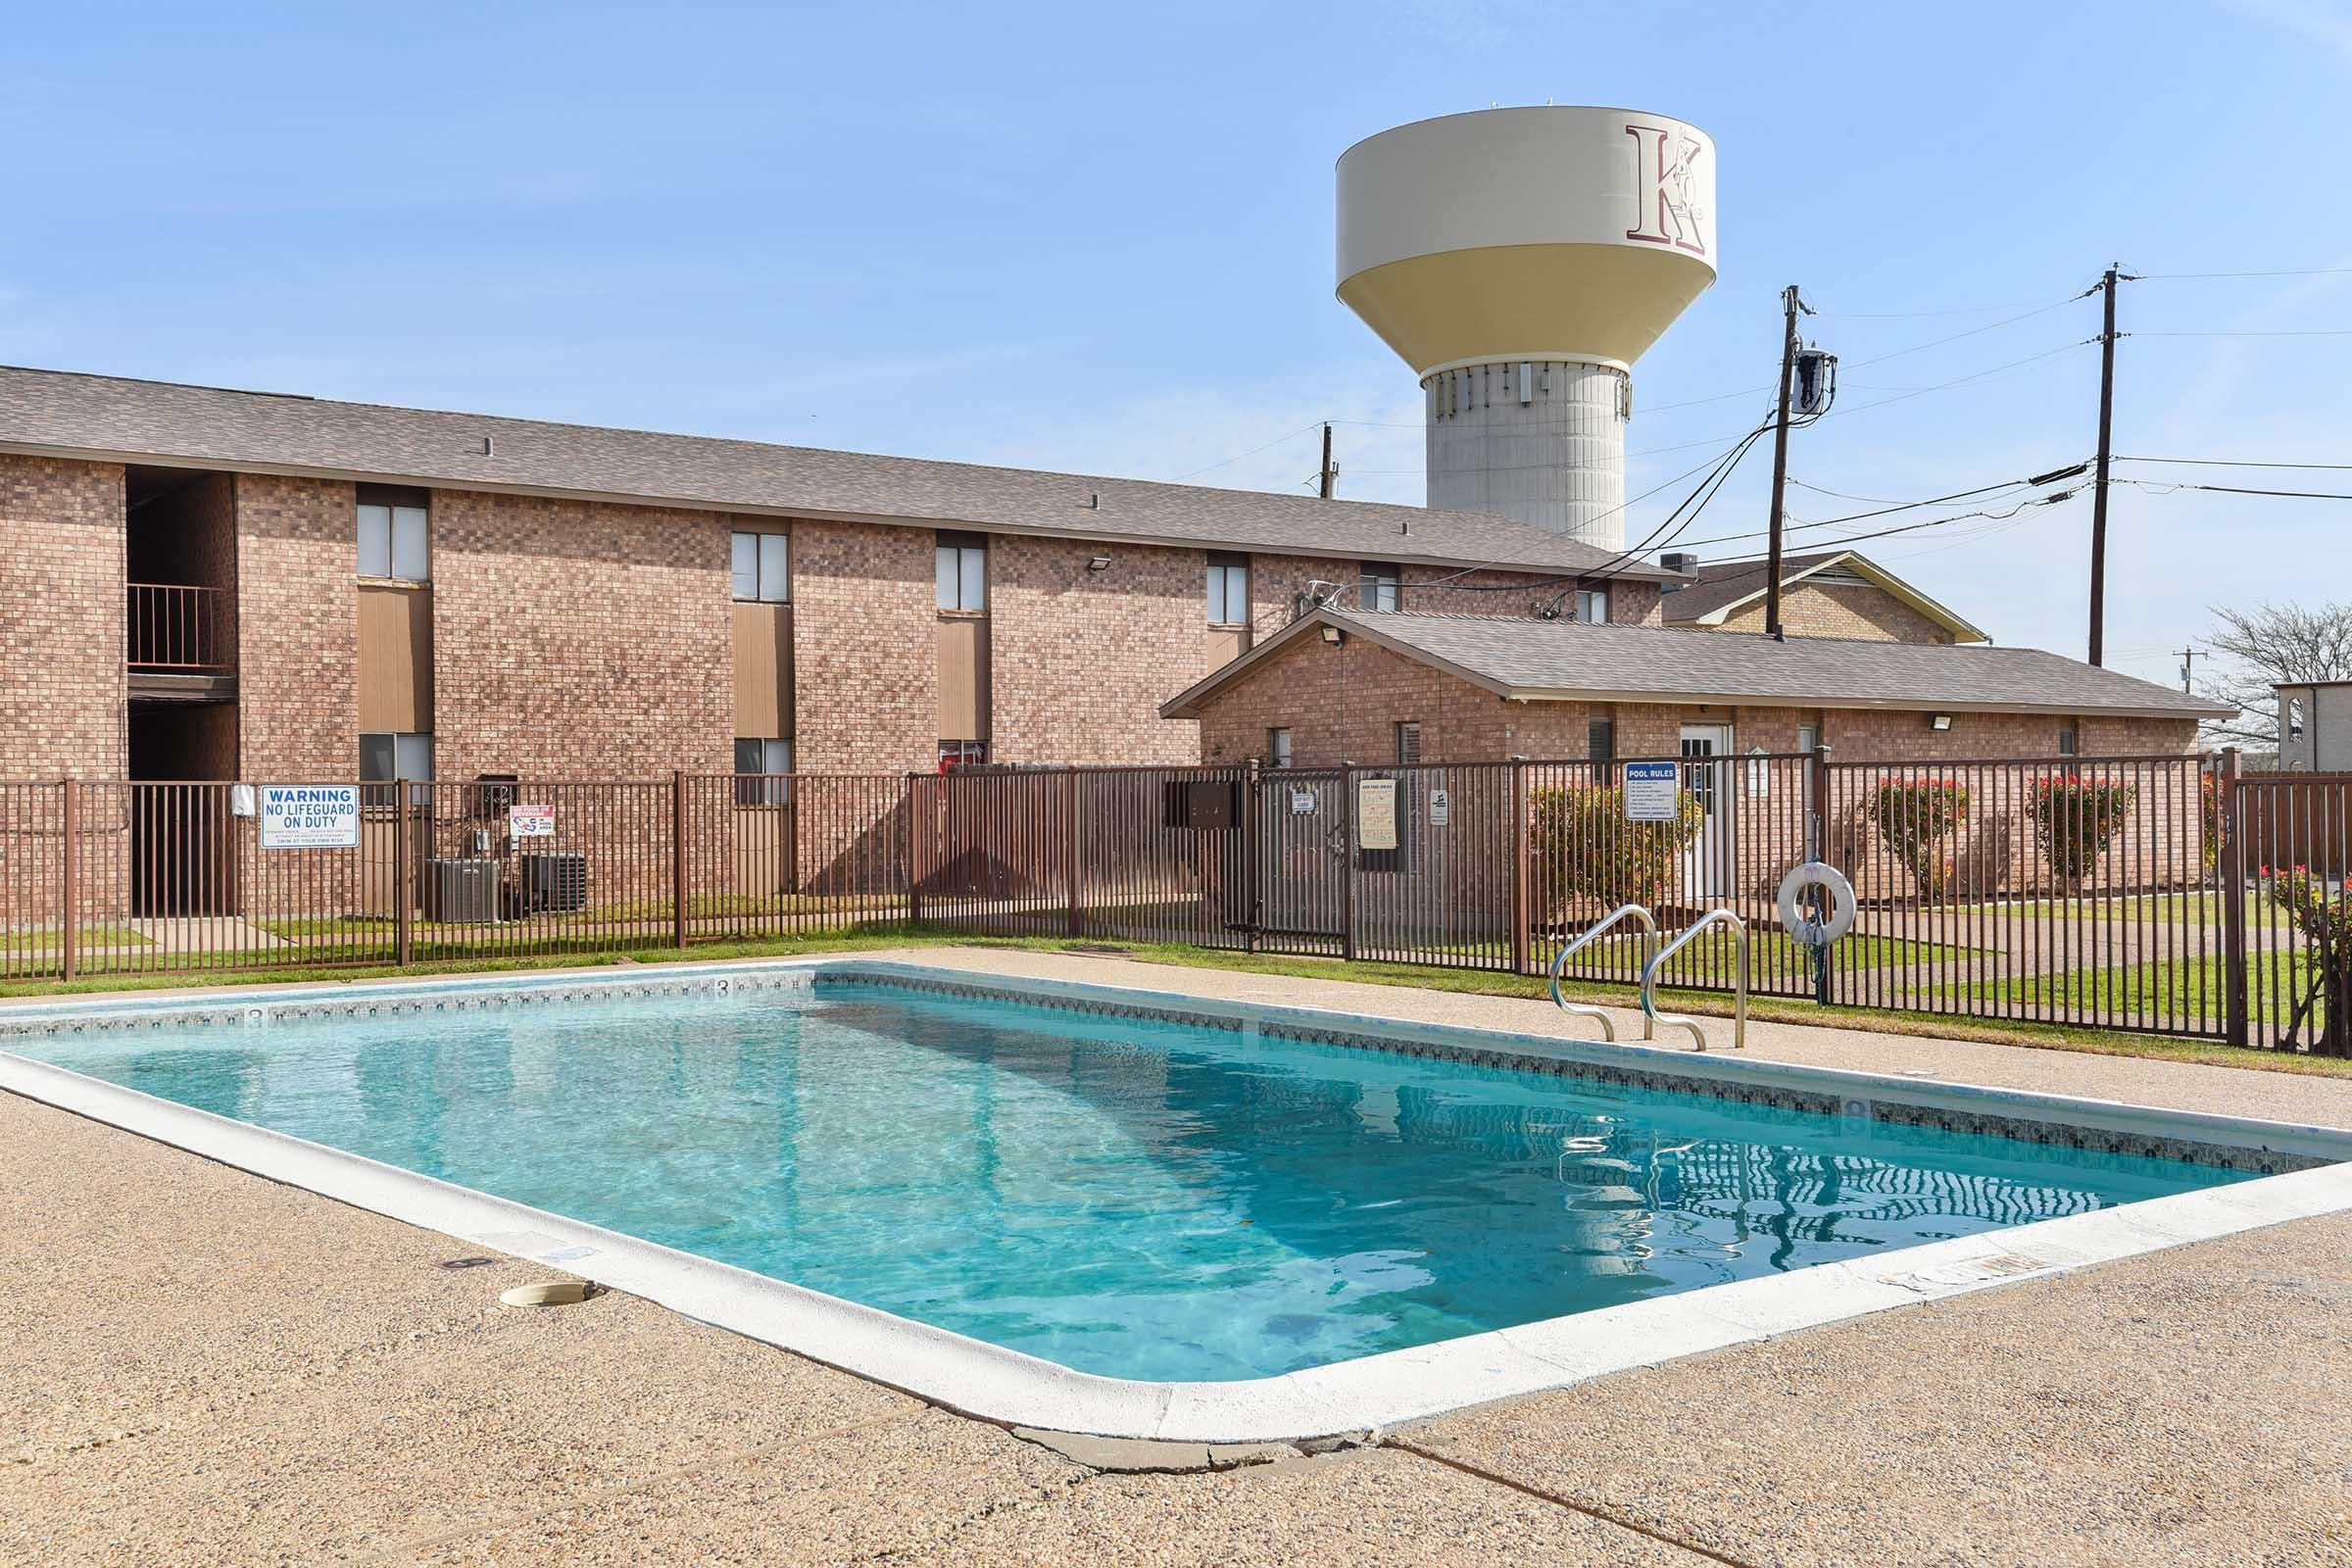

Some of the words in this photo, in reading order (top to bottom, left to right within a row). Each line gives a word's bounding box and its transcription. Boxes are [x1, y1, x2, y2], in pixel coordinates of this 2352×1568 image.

[1626, 124, 1705, 255] K
[1629, 769, 1648, 778] POOL
[270, 790, 351, 802] WARNING
[266, 804, 283, 815] NO
[287, 804, 354, 815] LIFEGUARD
[283, 816, 301, 828] ON
[305, 816, 337, 828] DUTY
